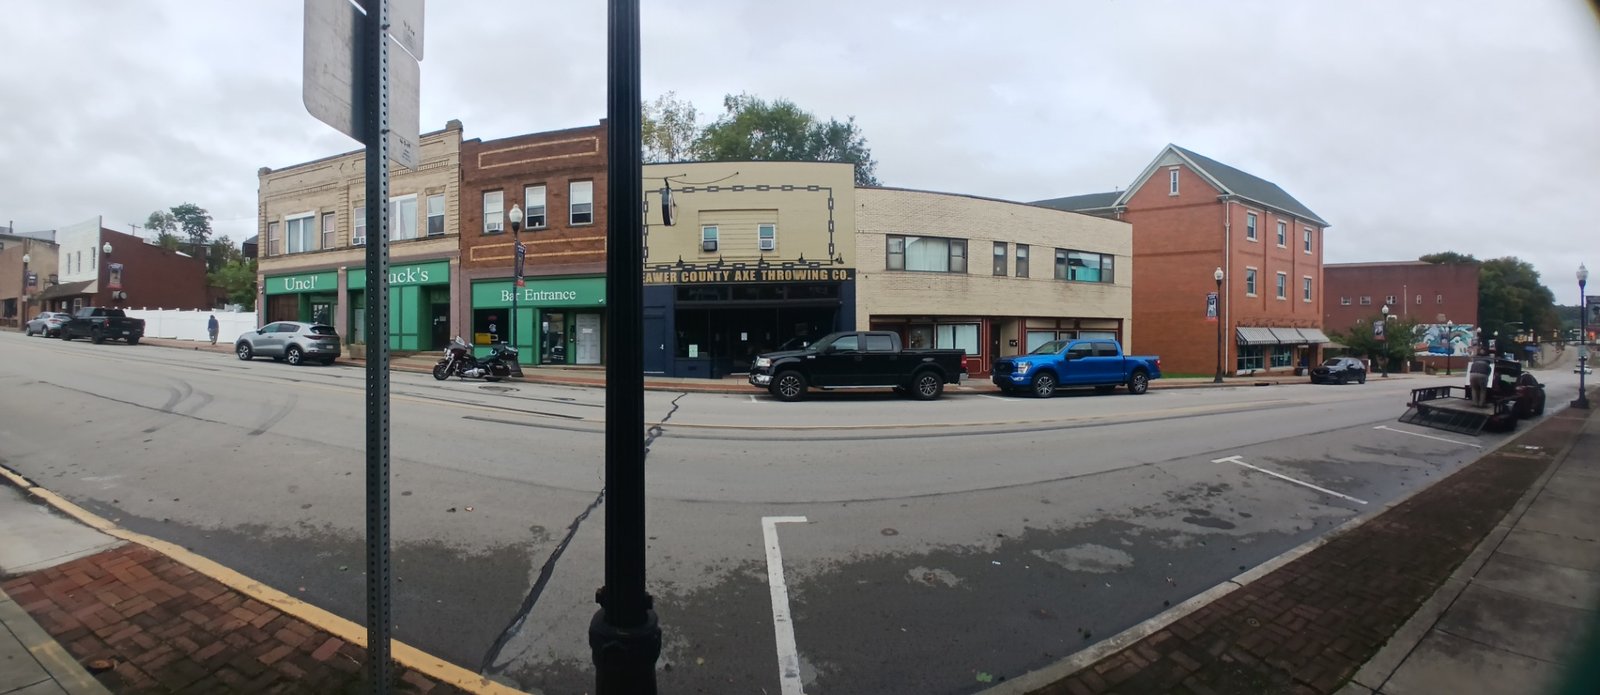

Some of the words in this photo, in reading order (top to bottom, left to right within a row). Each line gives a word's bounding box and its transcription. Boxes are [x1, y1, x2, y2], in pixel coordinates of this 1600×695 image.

[681, 270, 730, 282] COUNTY
[734, 270, 756, 281] AXE
[761, 269, 828, 281] THROWING
[501, 289, 521, 302] Bar
[524, 288, 577, 301] Entrance
